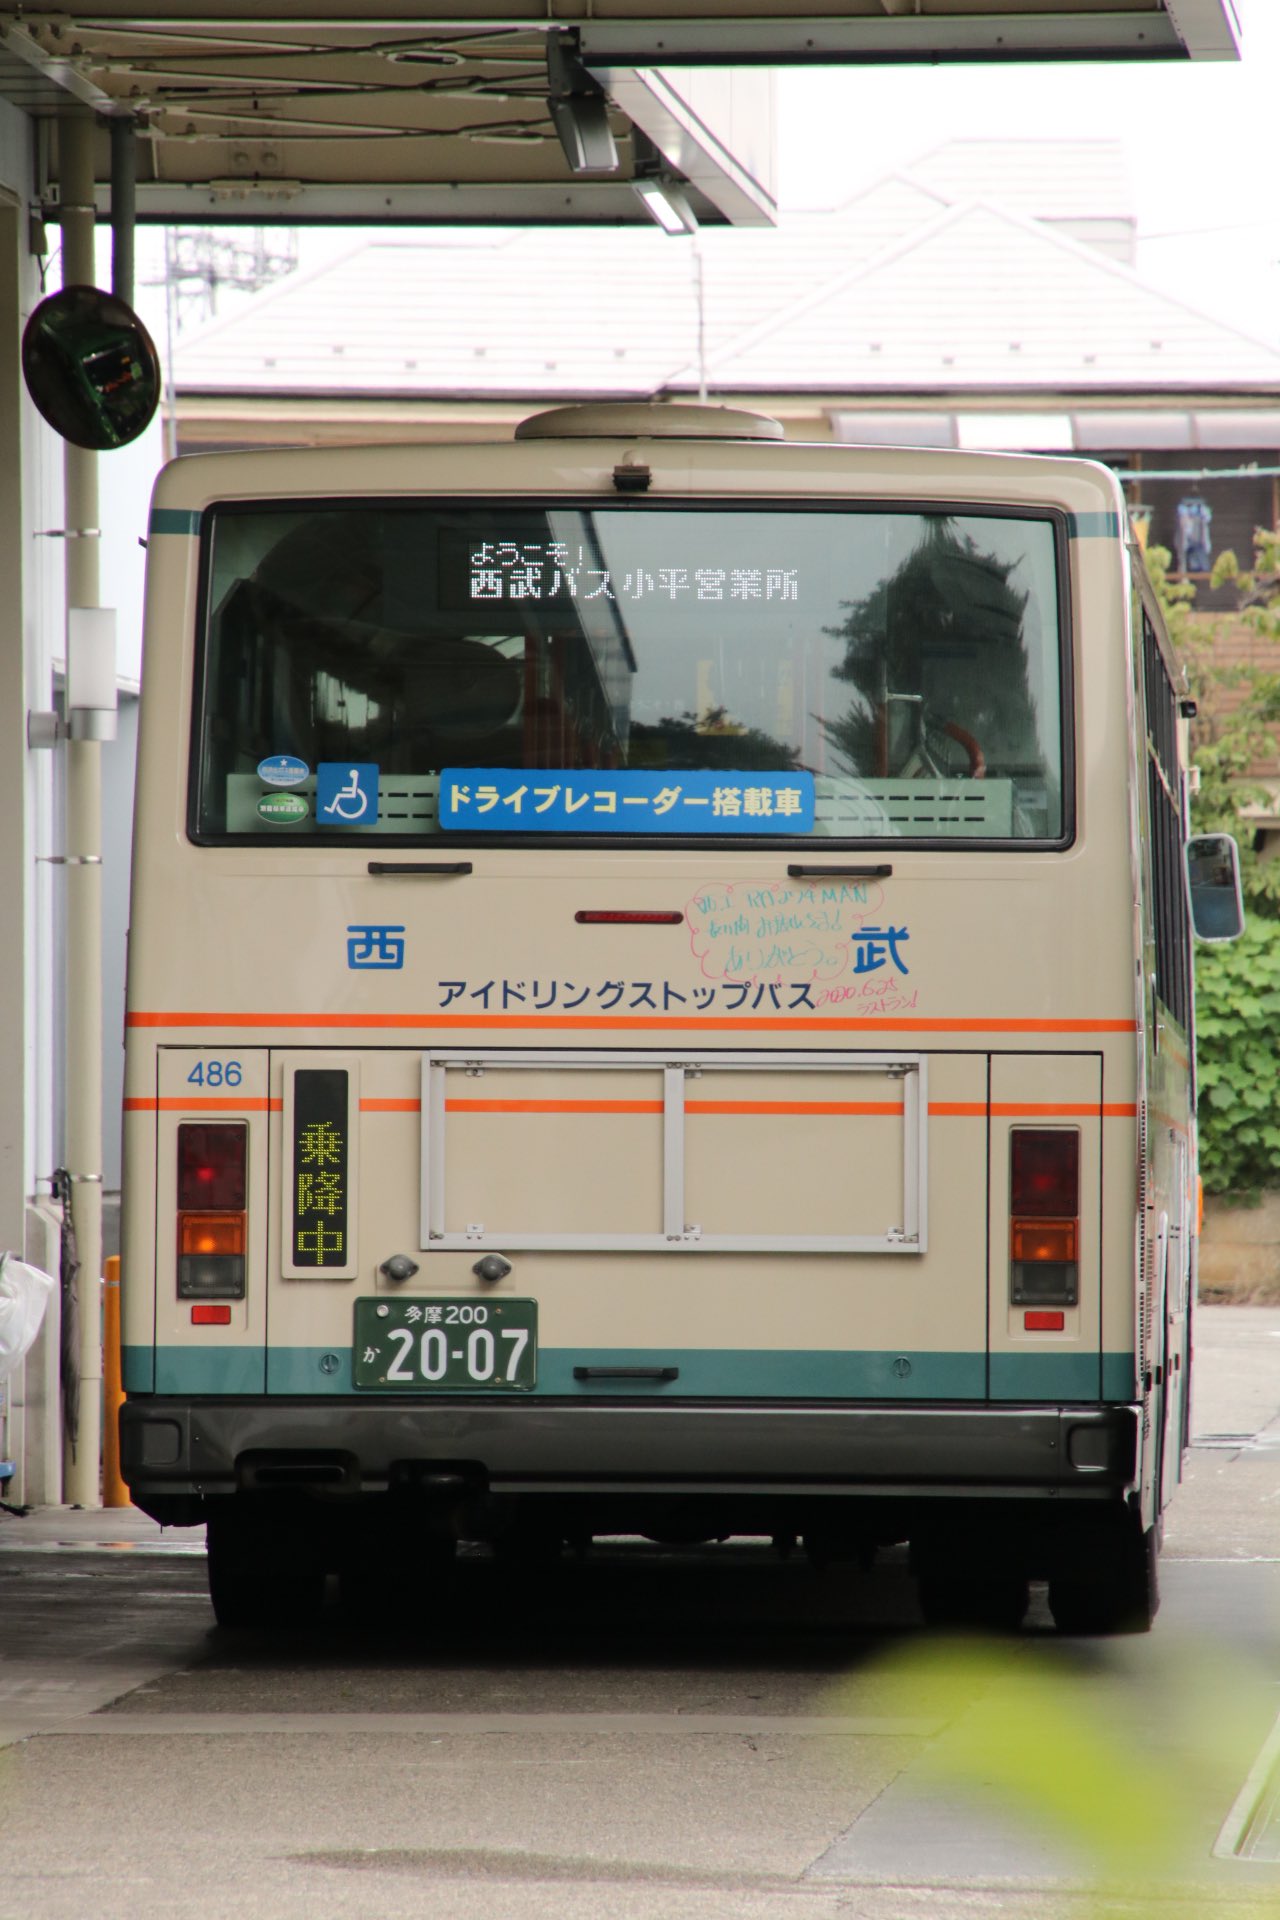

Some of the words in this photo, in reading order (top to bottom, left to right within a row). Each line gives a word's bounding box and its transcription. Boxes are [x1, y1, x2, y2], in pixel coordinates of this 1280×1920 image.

[470, 567, 799, 600] 西武バス小平営業所
[449, 784, 803, 817] ドライブレコーダー搭載車
[346, 925, 406, 970] 西
[851, 926, 910, 975] 武
[437, 980, 817, 1010] アイドリングストップバス
[187, 1061, 242, 1087] 486
[298, 1121, 343, 1265] 乗降中
[404, 1305, 488, 1325] 多摩200
[363, 1346, 381, 1363] か
[387, 1328, 528, 1381] 20-07
